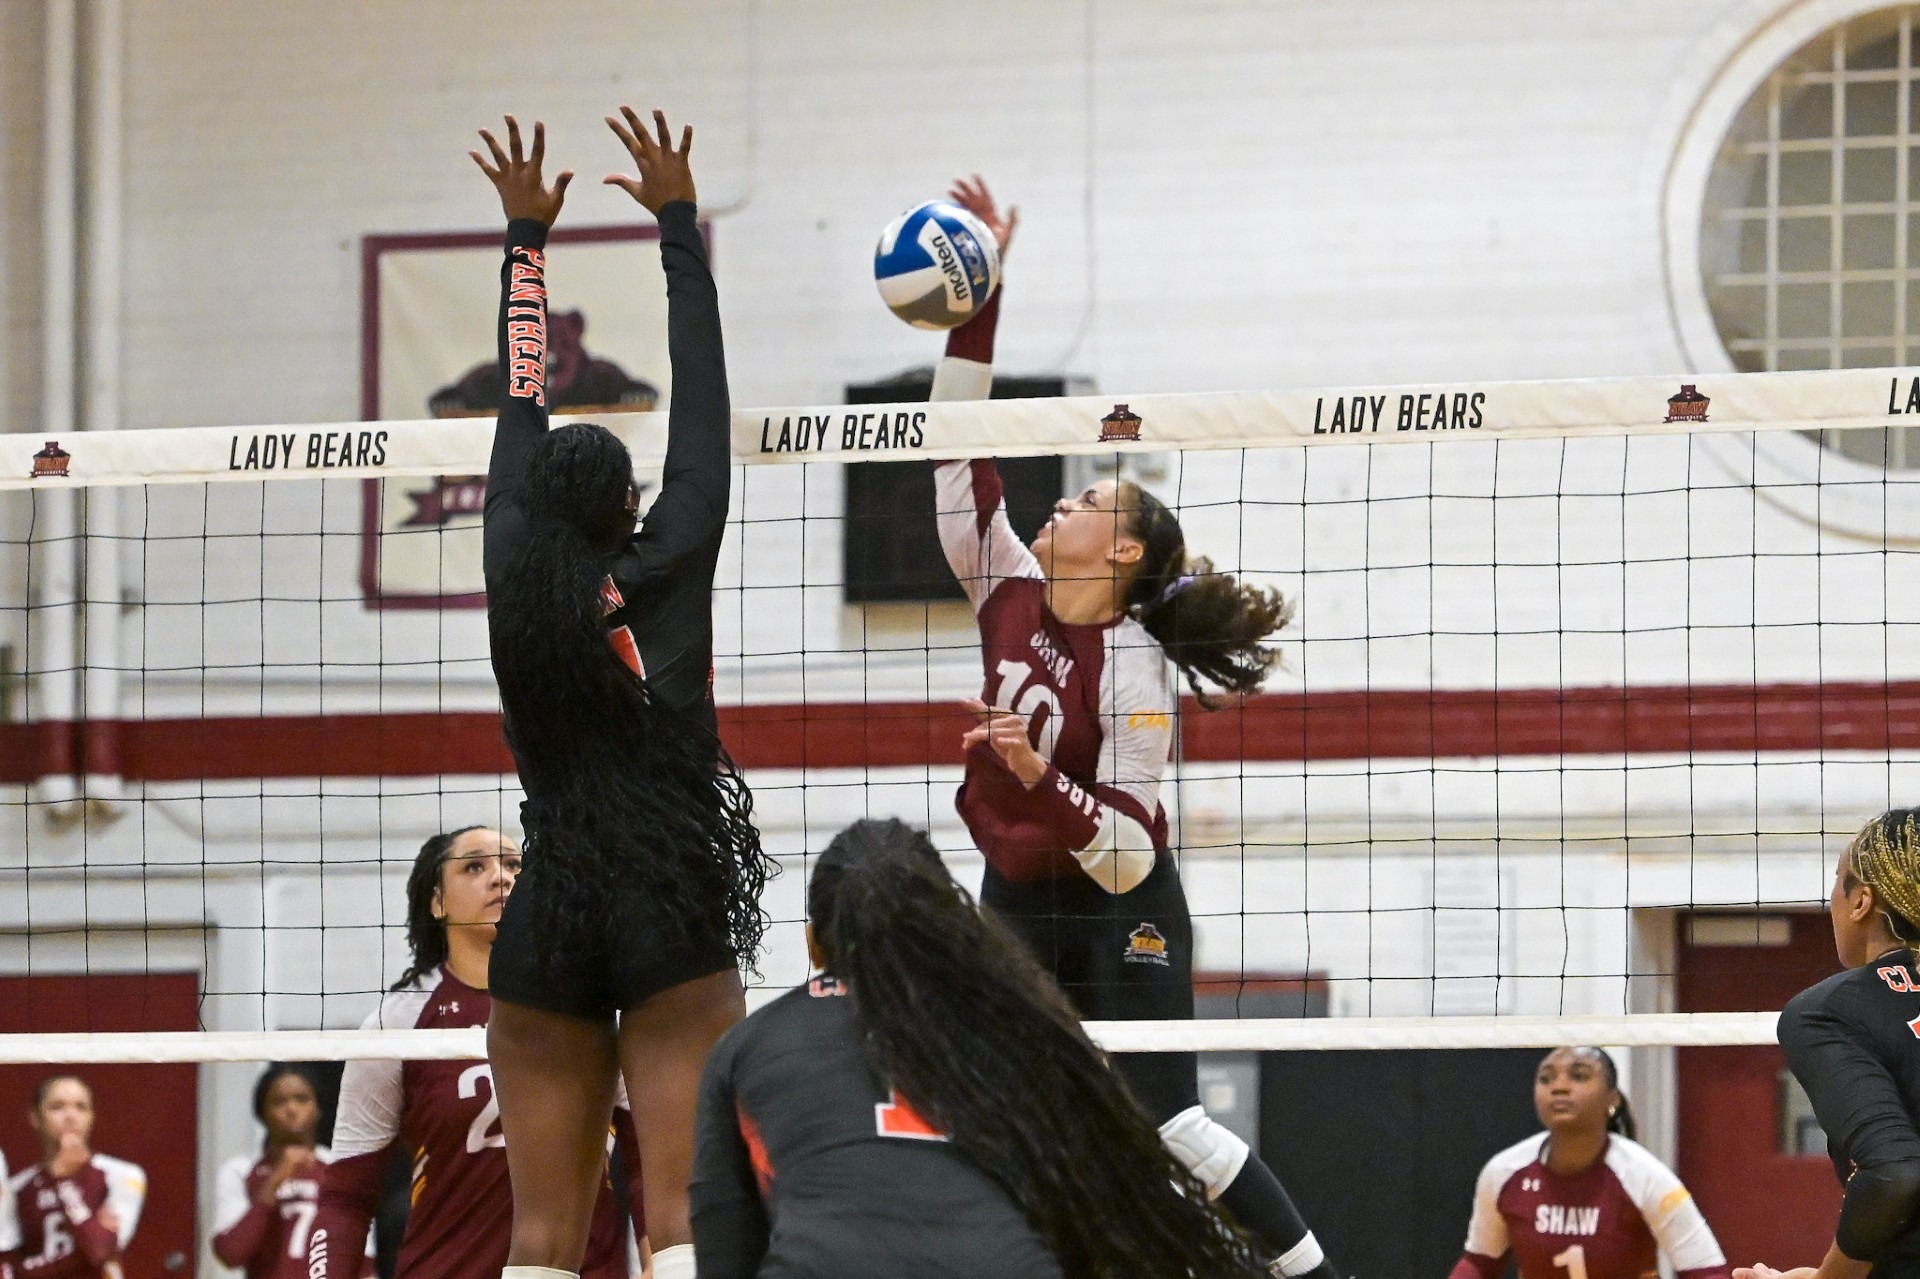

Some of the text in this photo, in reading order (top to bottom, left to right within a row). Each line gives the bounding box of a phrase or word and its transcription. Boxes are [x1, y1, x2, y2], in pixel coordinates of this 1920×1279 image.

[932, 235, 968, 301] molten
[508, 246, 547, 406] PANTHERS
[1314, 392, 1486, 434] LADY BEARS
[1888, 376, 1920, 415] LA
[229, 431, 388, 471] LADY BEARS
[761, 412, 926, 453] LADY BEARS
[995, 658, 1064, 764] 10
[281, 1201, 318, 1259] 7
[1534, 1203, 1600, 1236] SHAW
